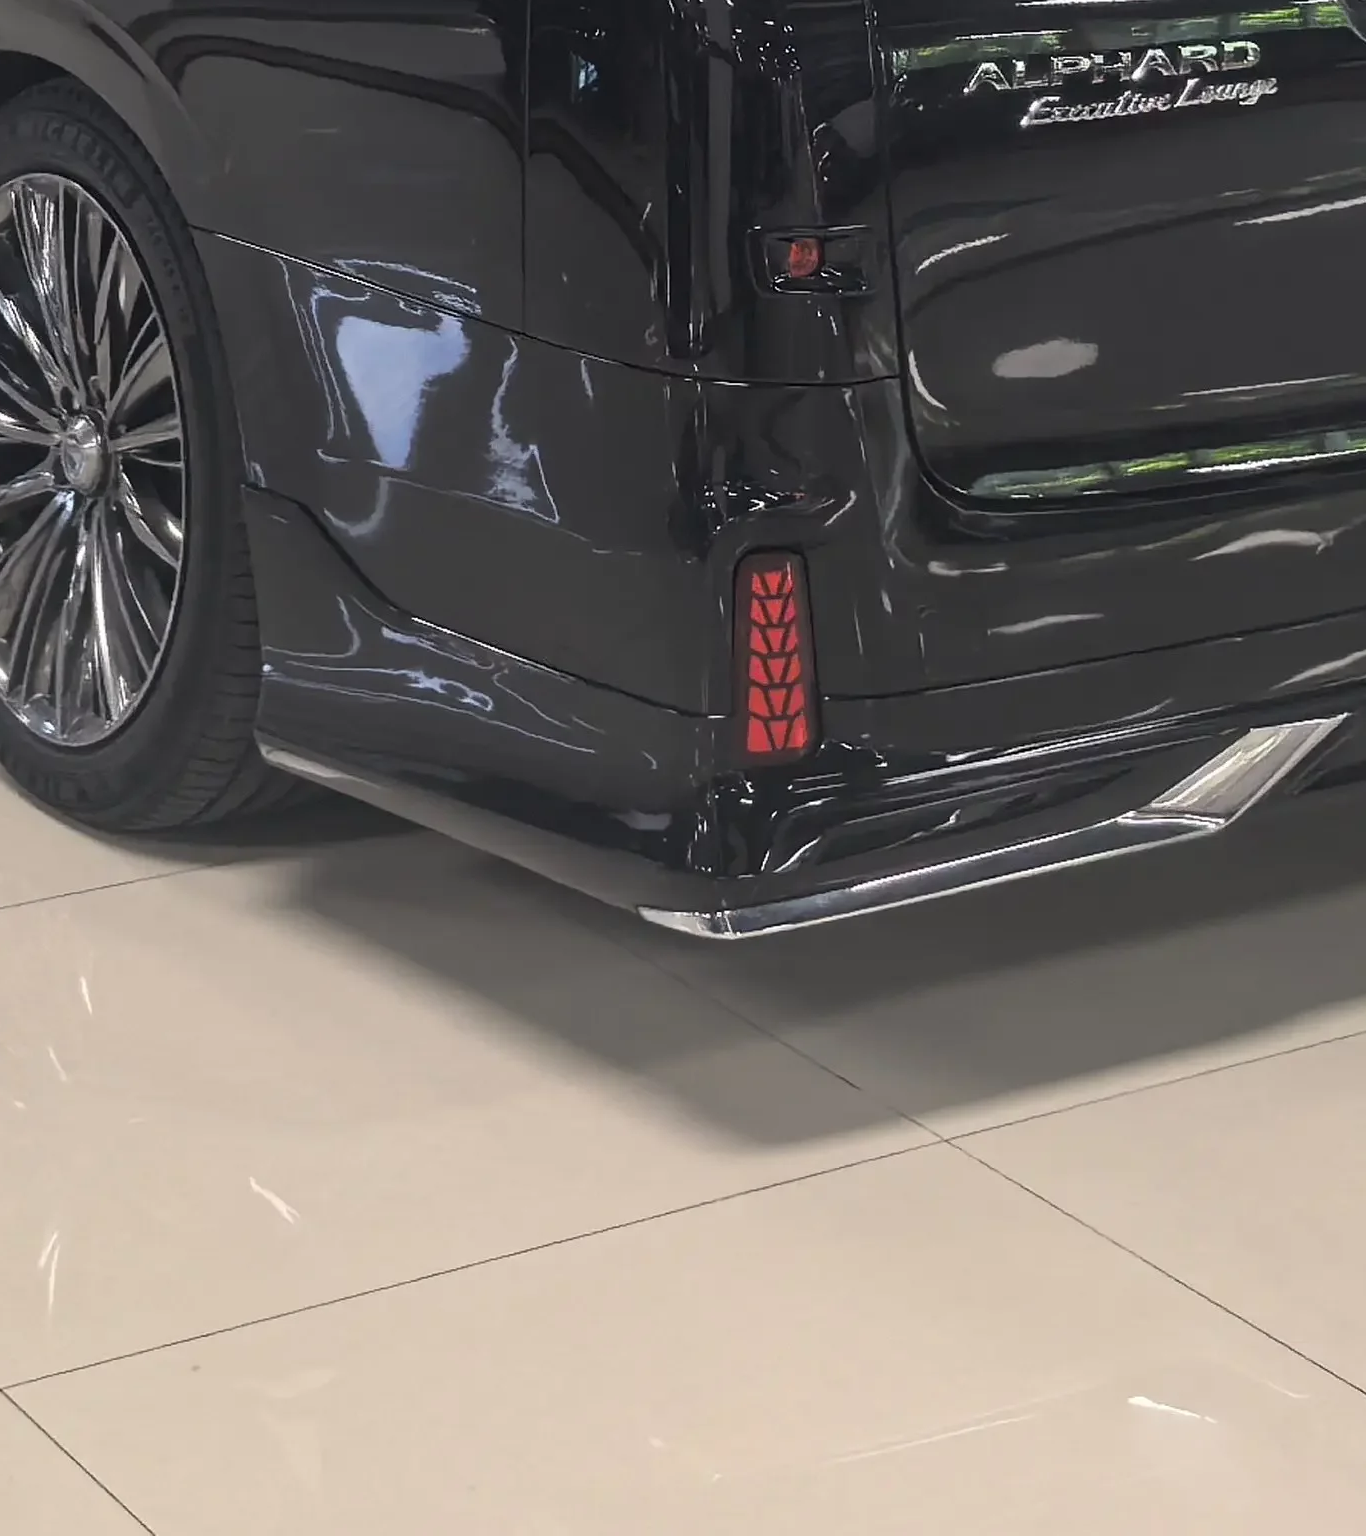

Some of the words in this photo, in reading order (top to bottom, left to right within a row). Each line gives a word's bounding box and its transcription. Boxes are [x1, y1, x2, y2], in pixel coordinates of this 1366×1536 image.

[962, 40, 1262, 95] ALPHARD
[1020, 89, 1173, 128] Executive
[1173, 76, 1279, 108] Lounge
